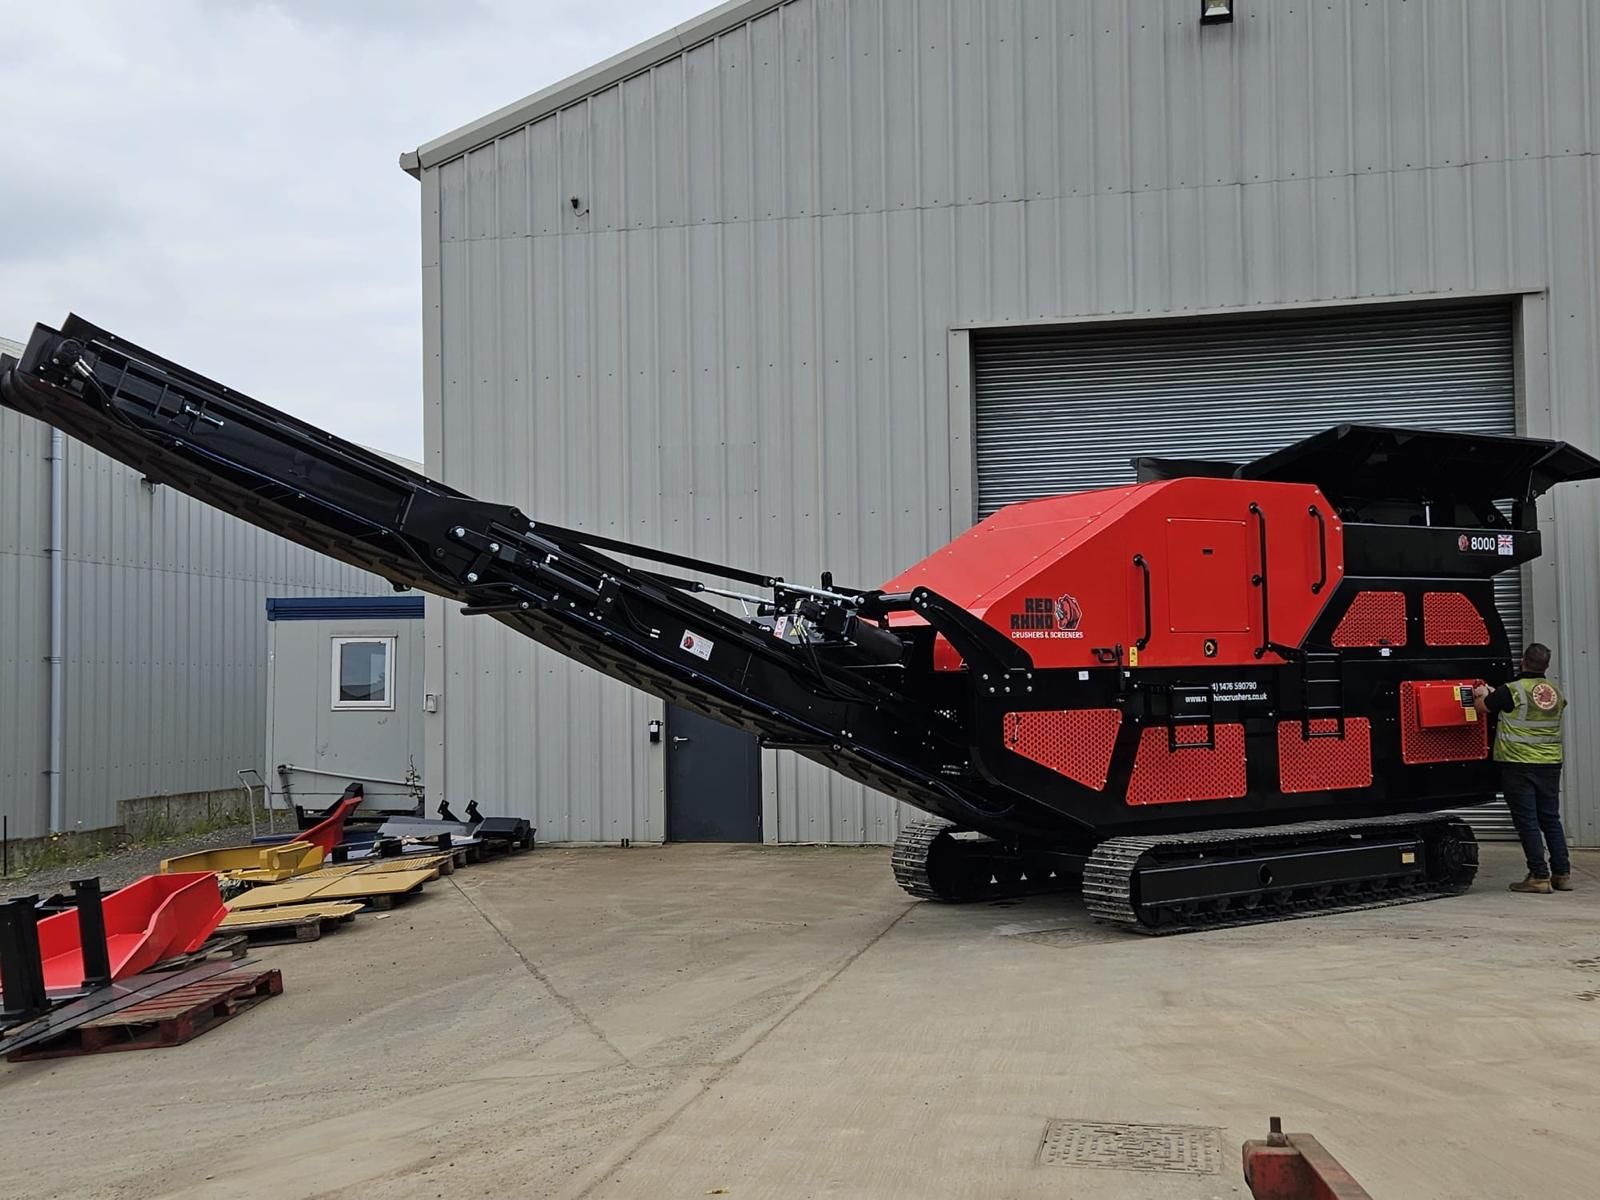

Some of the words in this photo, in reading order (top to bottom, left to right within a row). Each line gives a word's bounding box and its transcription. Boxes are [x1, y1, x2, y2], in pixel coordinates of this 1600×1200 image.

[1471, 536, 1496, 550] 8000
[1026, 598, 1052, 612] RED
[1011, 614, 1052, 628] RHINO
[1219, 682, 1233, 690] 1476
[1234, 682, 1256, 690] 590790
